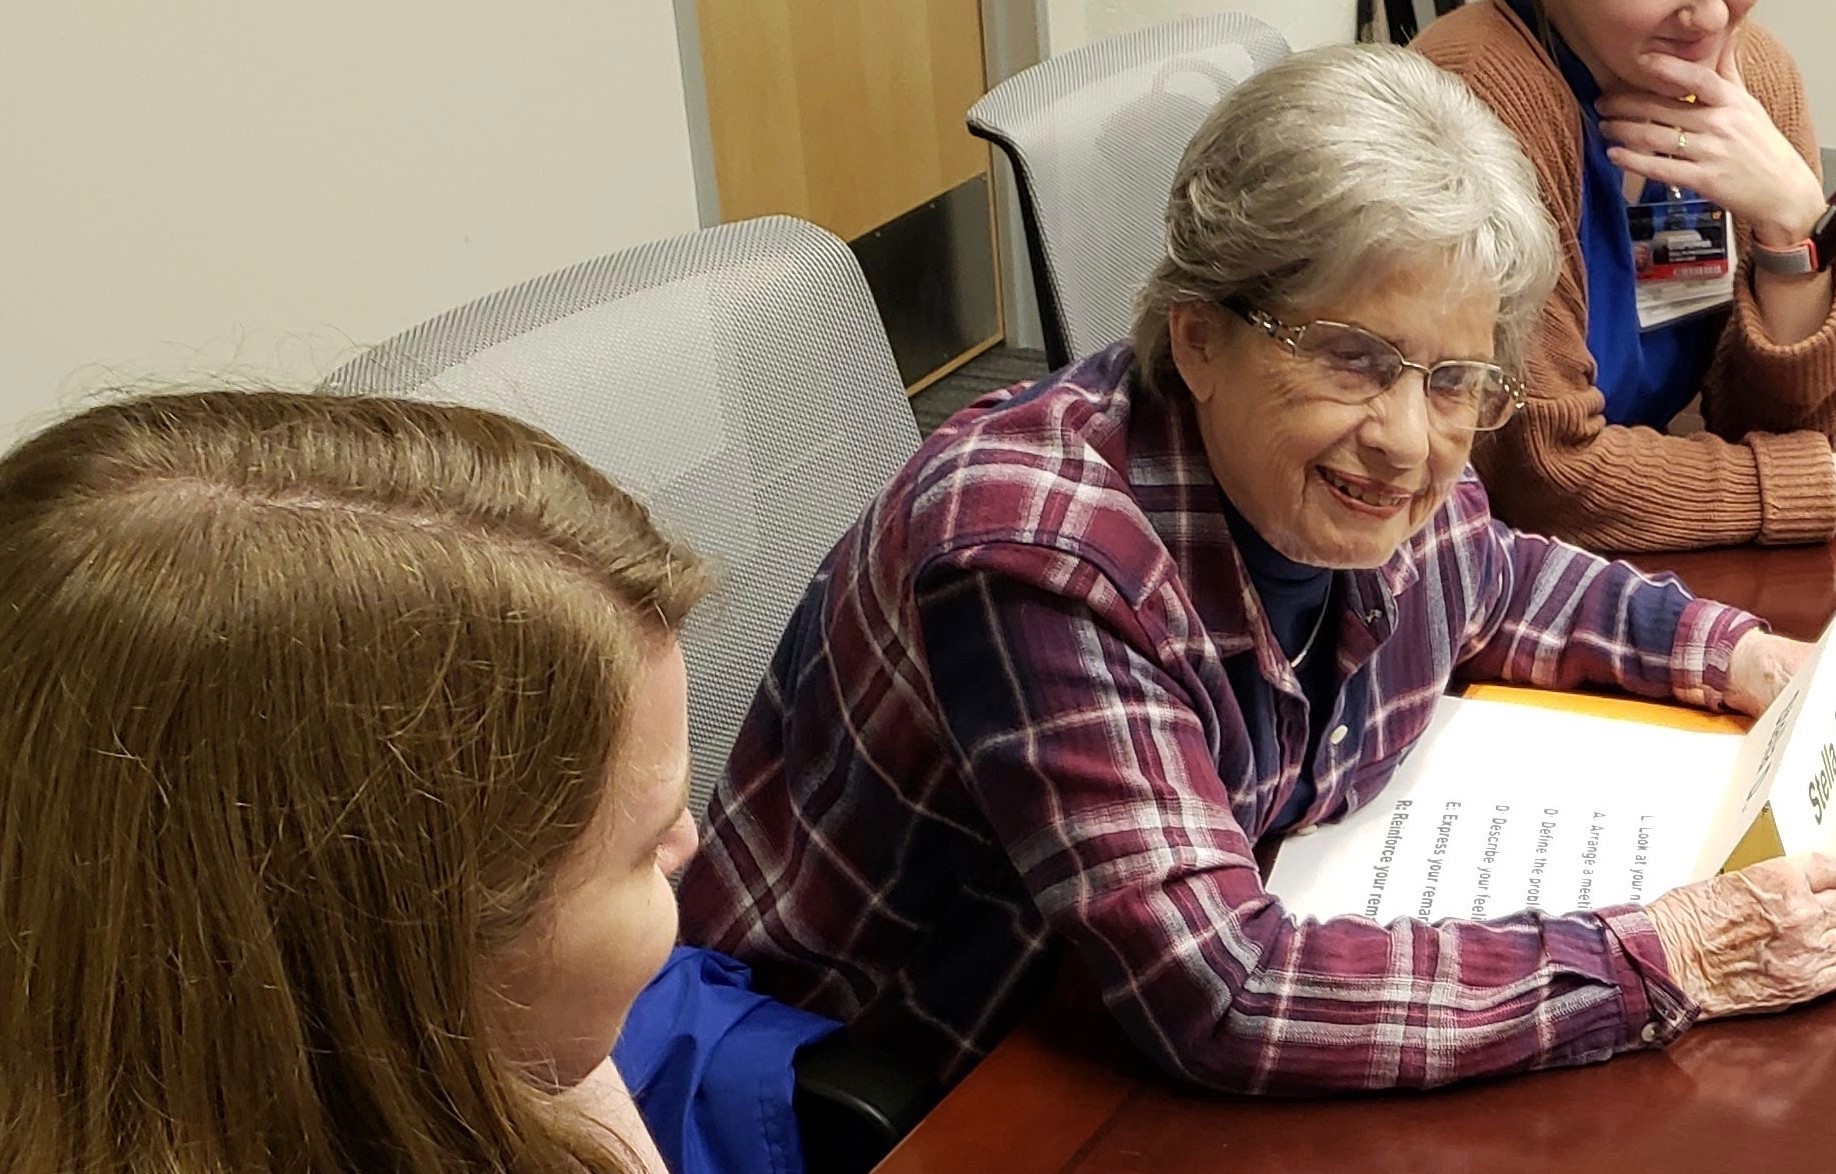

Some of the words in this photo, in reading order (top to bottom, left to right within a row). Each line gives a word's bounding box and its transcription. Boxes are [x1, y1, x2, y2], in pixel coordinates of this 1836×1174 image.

[1395, 799, 1413, 811] R:
[1379, 812, 1409, 863] Reinforce
[1433, 814, 1459, 855] Express
[1483, 817, 1508, 864] Describe
[1536, 821, 1557, 854] Define
[1581, 824, 1604, 865] Arrange
[1637, 827, 1653, 851] Look
[1427, 858, 1444, 882] your
[1532, 857, 1547, 875] the
[1634, 854, 1647, 865] at
[1373, 865, 1391, 890] your
[1477, 866, 1492, 890] your
[1629, 868, 1643, 891] your
[1526, 878, 1542, 906] probl
